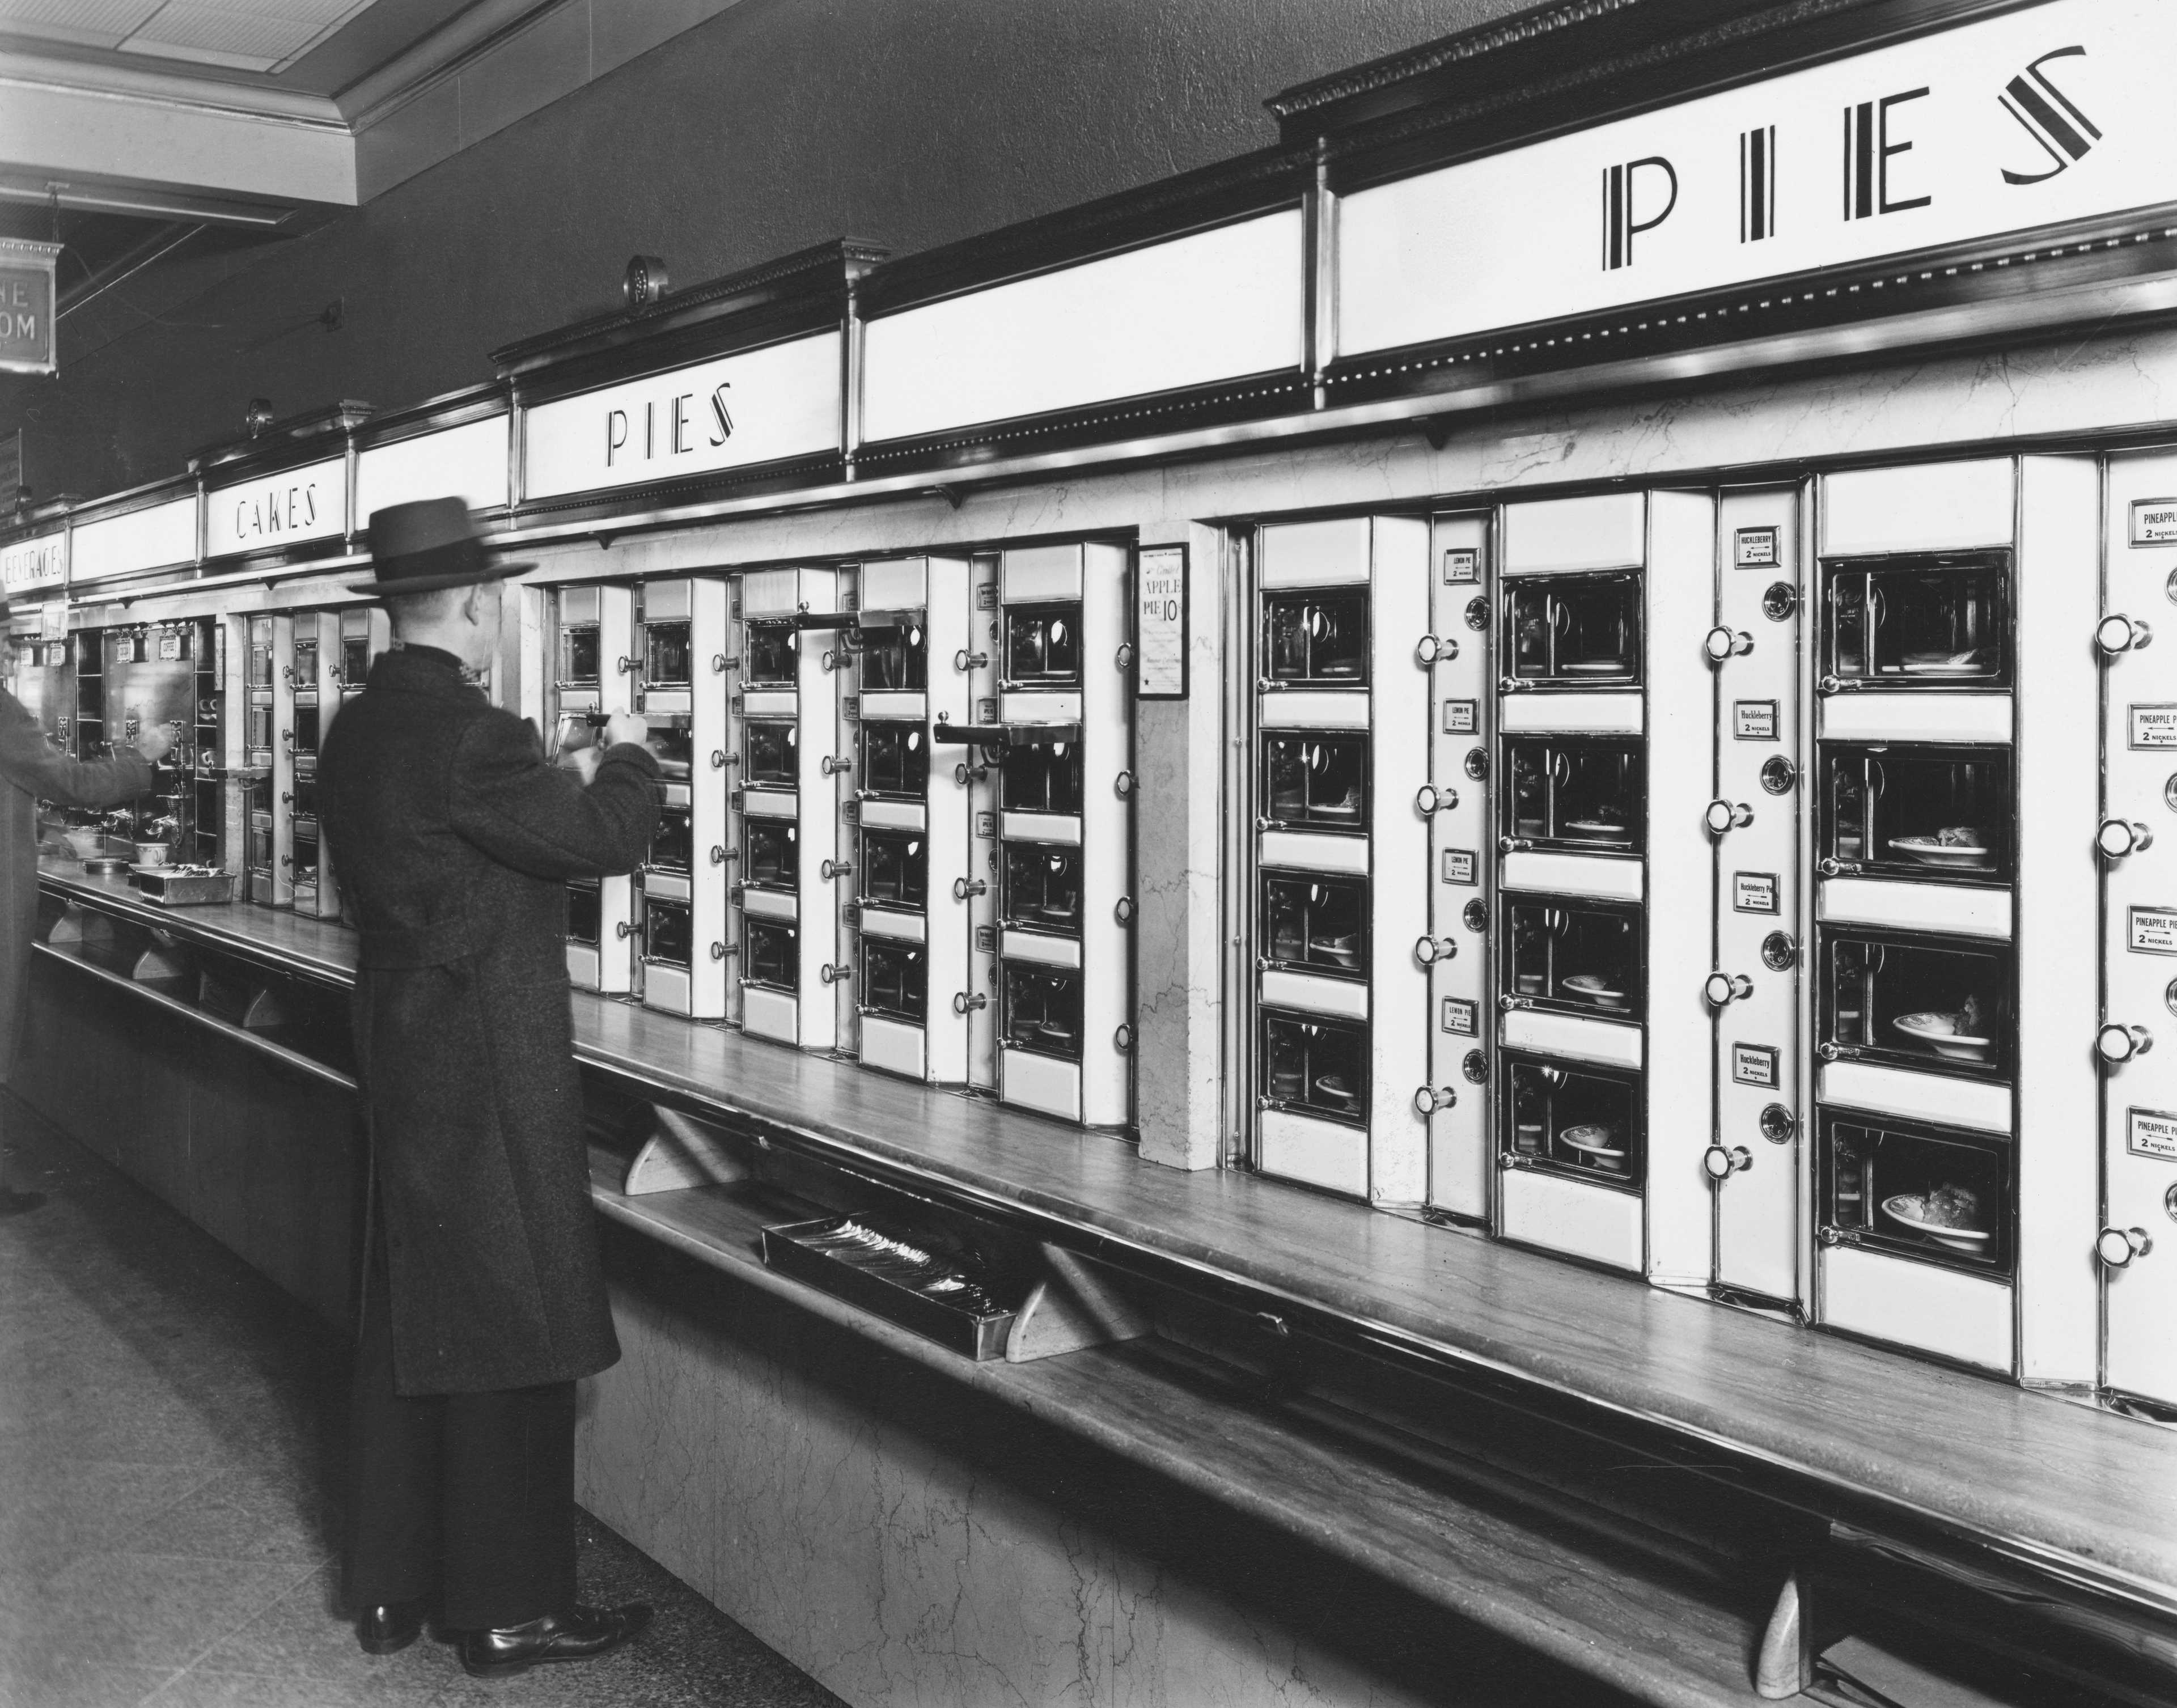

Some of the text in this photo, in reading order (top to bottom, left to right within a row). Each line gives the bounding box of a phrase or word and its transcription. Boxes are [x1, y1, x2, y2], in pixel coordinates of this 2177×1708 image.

[1602, 45, 2103, 271] PIES
[605, 382, 734, 468] PIES
[237, 484, 316, 539] CAKES
[2144, 512, 2177, 524] PINEAPPL
[2146, 529, 2153, 538] 2
[1741, 535, 1771, 544] HUCKLEBERRY
[1143, 579, 1181, 594] APPLE
[1144, 601, 1162, 615] PIE
[1742, 710, 1772, 721] Huckleberry
[2140, 715, 2170, 723] PINEAPPLE
[2143, 732, 2149, 740] 2
[1740, 883, 1765, 893] Huckleberry
[2136, 917, 2167, 928] PINEAPPLE
[2138, 935, 2145, 943] 2
[1450, 1006, 1463, 1015] LEMON
[1740, 1054, 1769, 1069] Huckleberry
[2138, 1121, 2168, 1134] PINEAPPLE
[2141, 1138, 2175, 1151] 2 NICKELS
